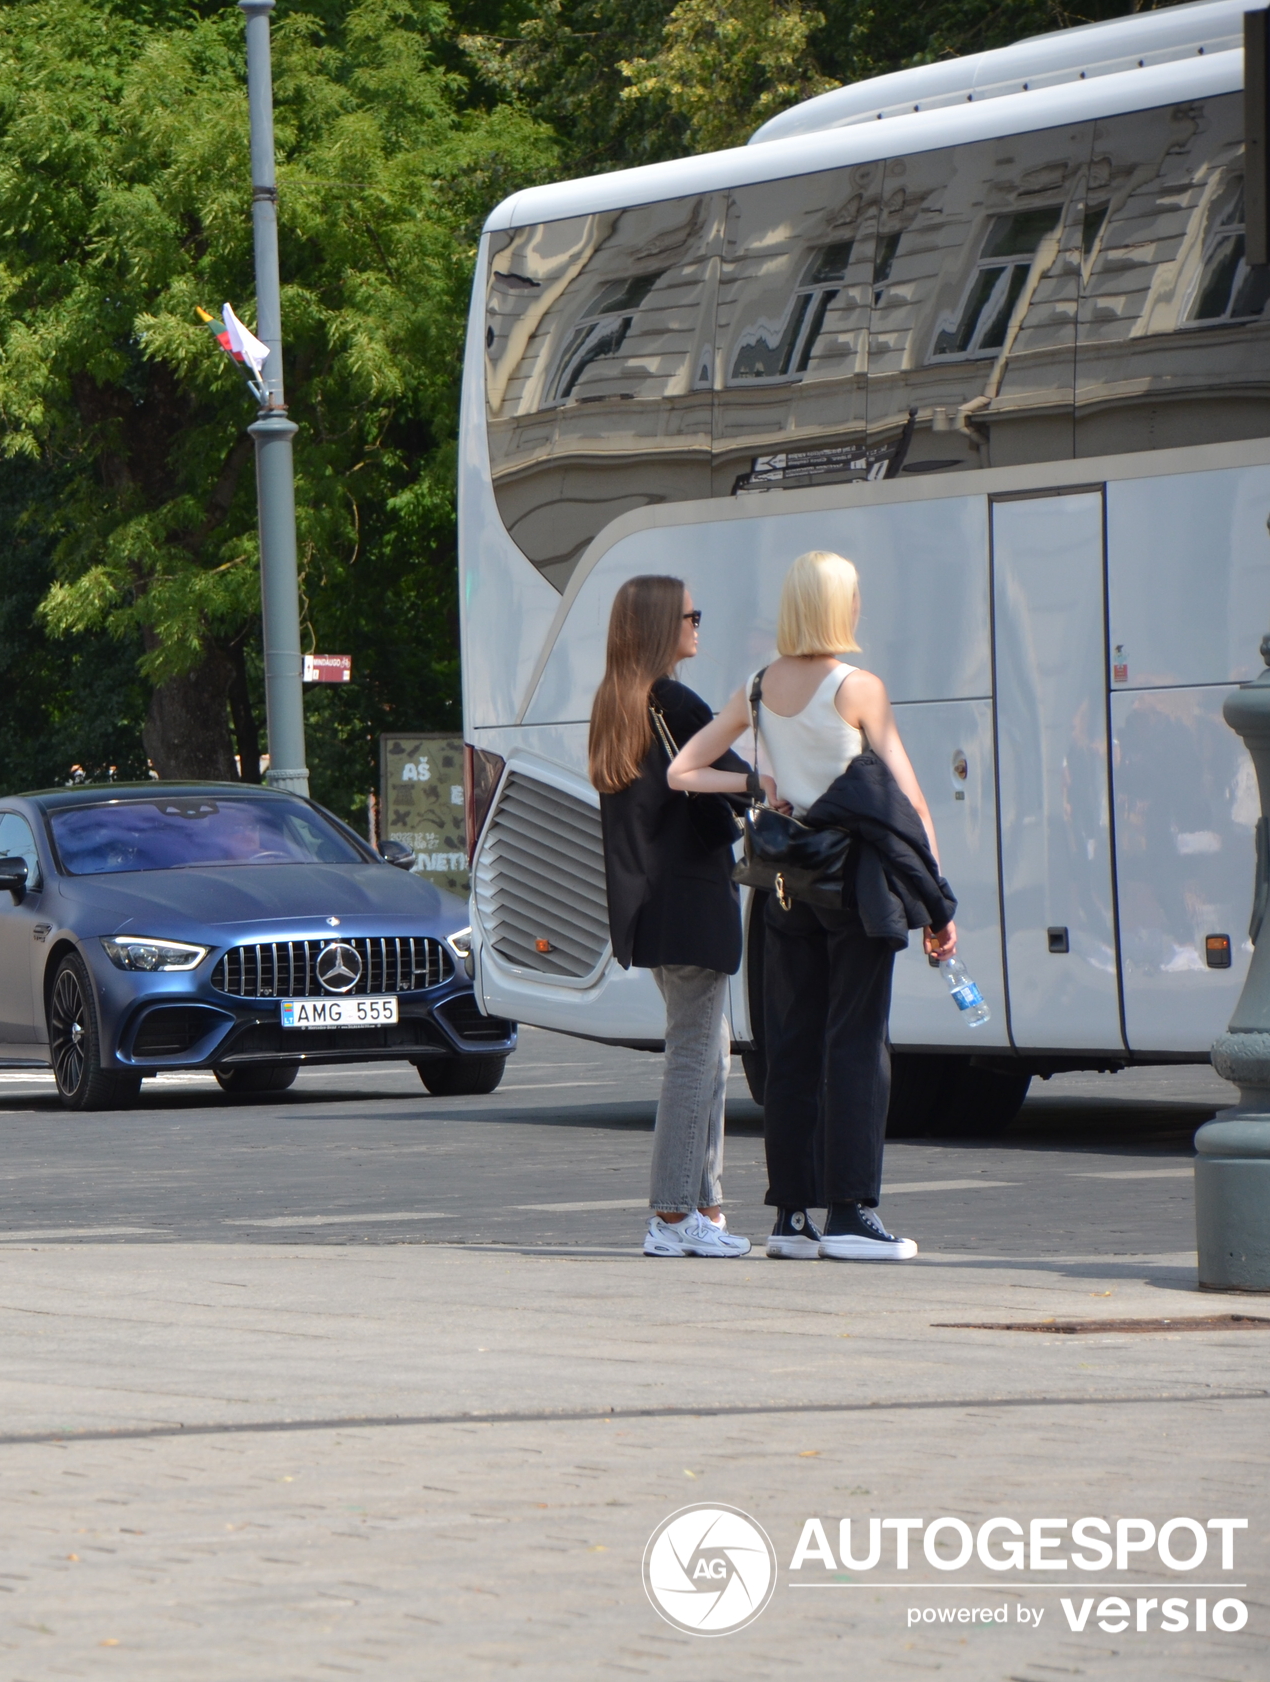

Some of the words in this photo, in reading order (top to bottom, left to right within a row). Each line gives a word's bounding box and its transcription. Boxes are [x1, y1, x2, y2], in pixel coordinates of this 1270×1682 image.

[402, 756, 431, 782] AŠ
[297, 1003, 342, 1022] AMG
[357, 1001, 393, 1020] 555
